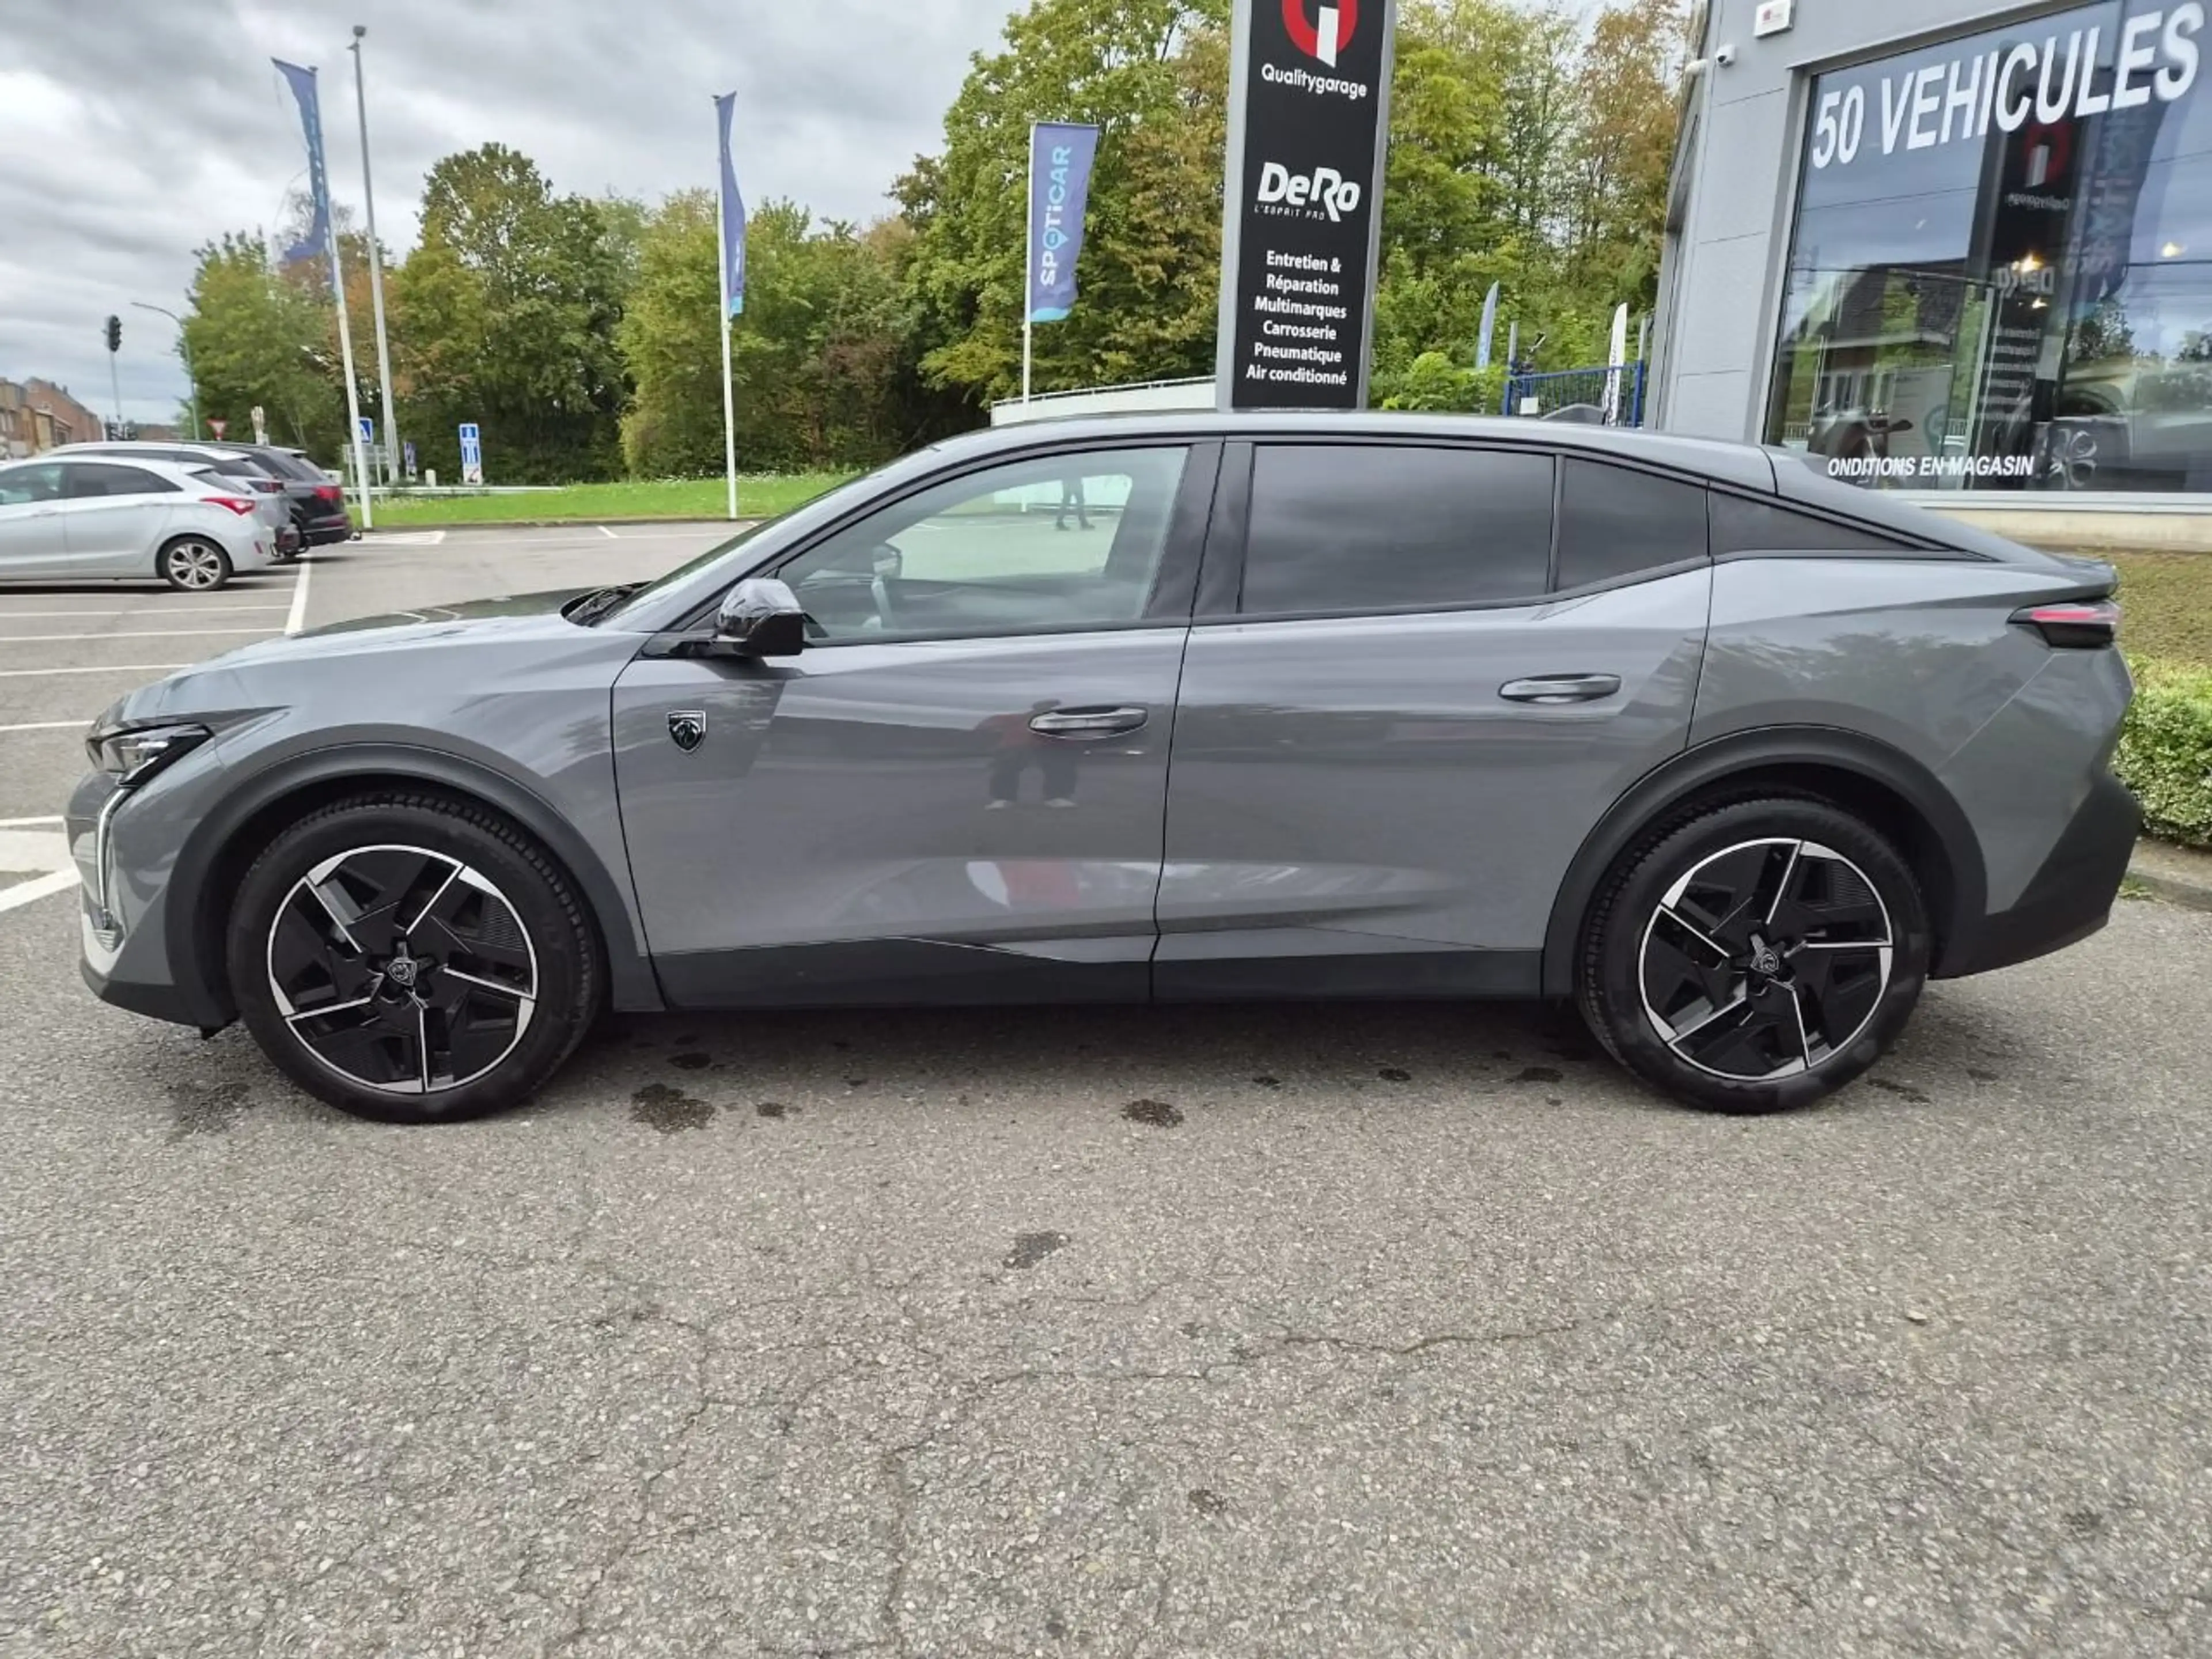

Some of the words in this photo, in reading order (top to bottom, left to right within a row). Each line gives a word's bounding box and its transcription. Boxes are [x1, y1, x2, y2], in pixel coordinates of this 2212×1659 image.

[1261, 63, 1368, 100] Qualitygarage
[1812, 85, 1864, 169] 50
[1881, 3, 2205, 155] VEHICULES
[1257, 161, 1361, 222] DeRo
[1267, 250, 1328, 271] Entretien
[1331, 257, 1342, 273] &
[1267, 274, 1339, 295] Réparation
[1255, 296, 1347, 320] Multimarques
[1263, 320, 1337, 340] Carrosserie
[1254, 342, 1342, 365] Pneumatique
[1246, 365, 1267, 380] Air
[1269, 367, 1347, 385] conditionné
[1827, 457, 1915, 476] ONDITIONS
[1919, 457, 1944, 475] EN
[1948, 456, 2034, 476] MAGASIN
